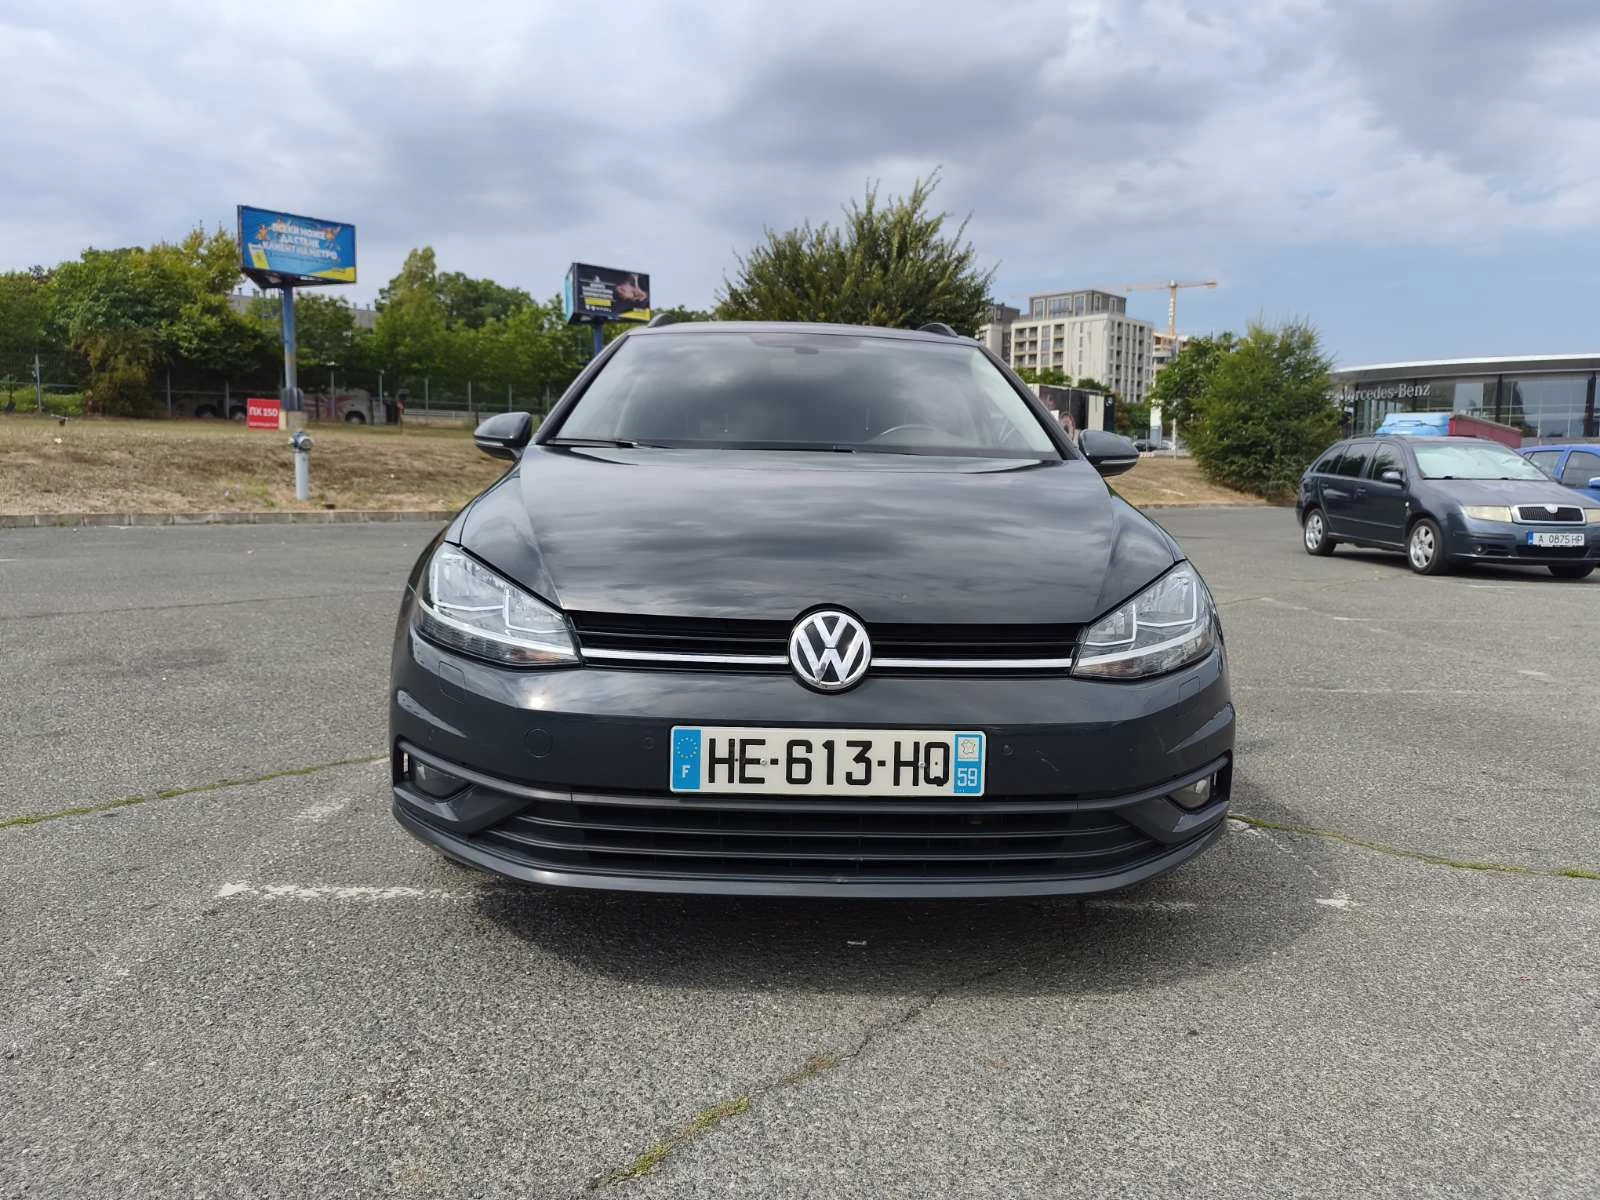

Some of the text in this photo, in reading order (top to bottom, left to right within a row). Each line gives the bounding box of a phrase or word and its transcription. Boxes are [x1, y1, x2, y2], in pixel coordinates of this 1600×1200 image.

[1549, 535, 1570, 544] 0875
[681, 738, 978, 787] F HE-613-HQ 59
